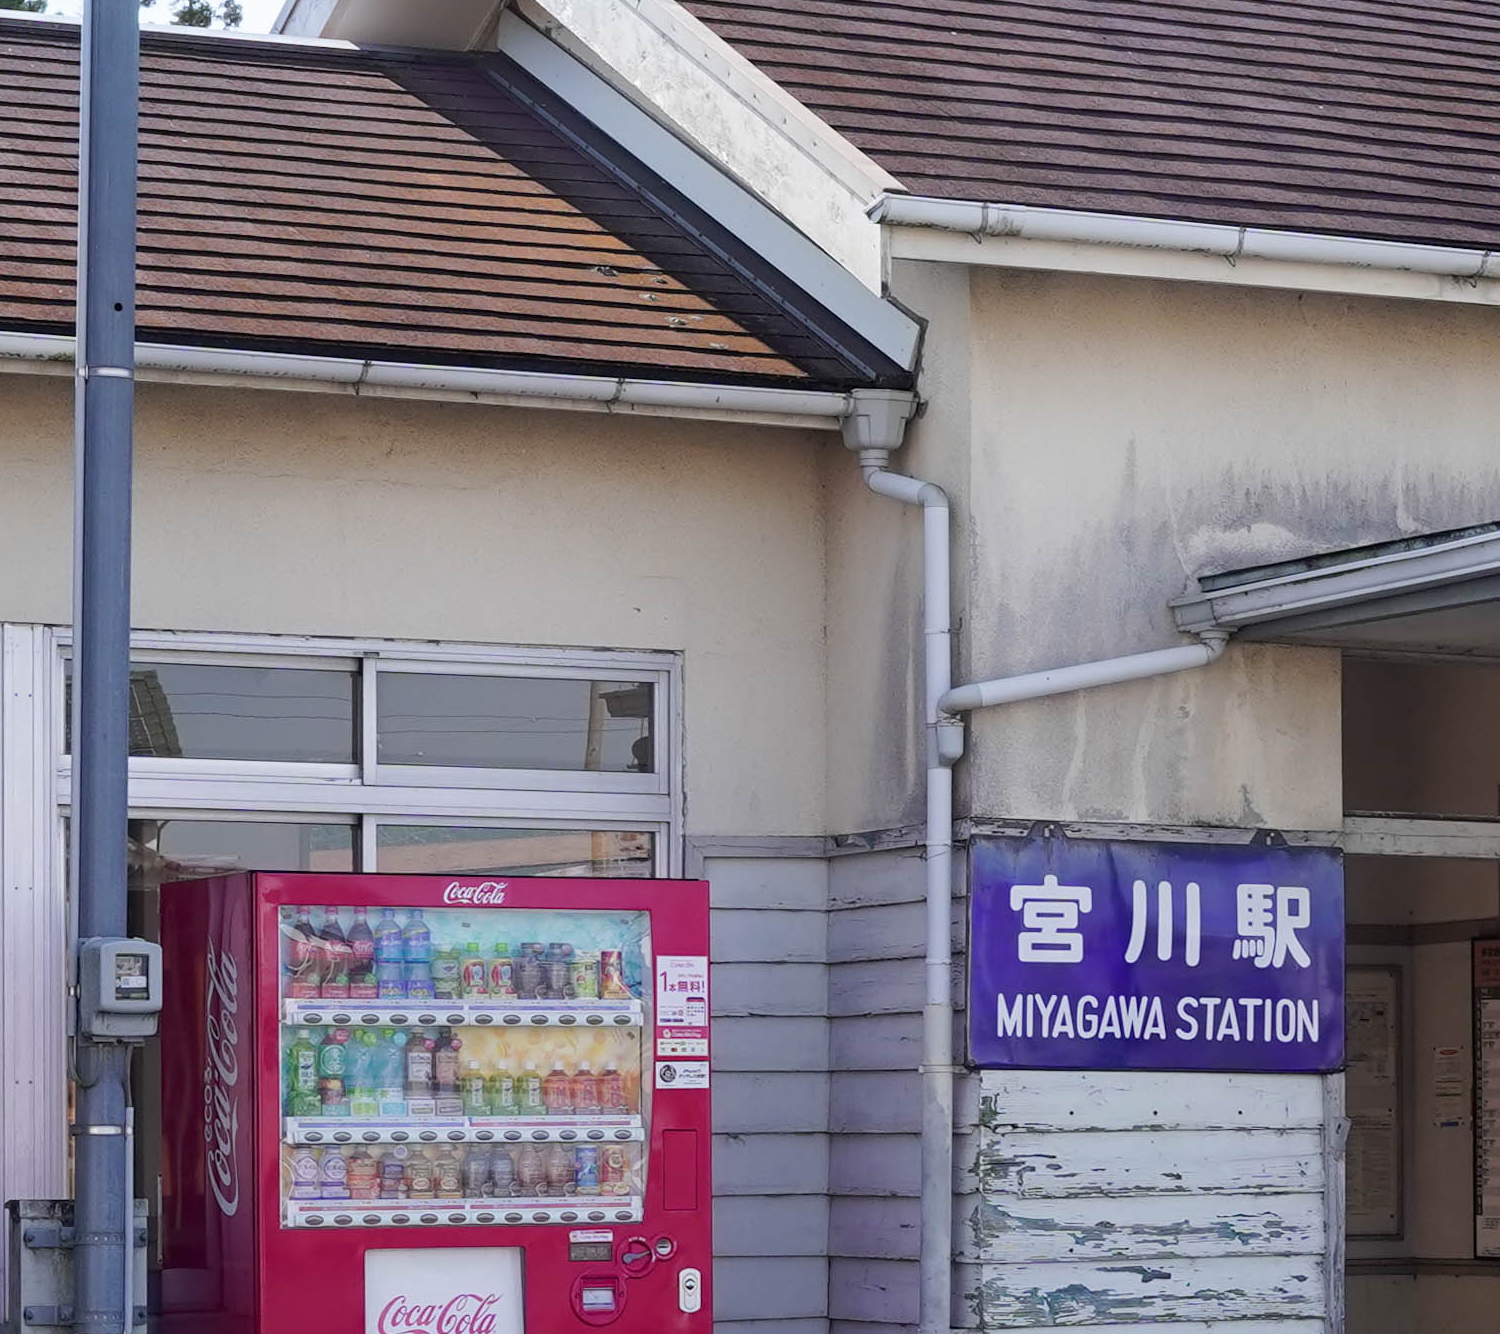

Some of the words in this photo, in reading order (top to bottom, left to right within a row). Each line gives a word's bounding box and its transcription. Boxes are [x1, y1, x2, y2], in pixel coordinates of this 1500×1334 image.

[443, 881, 505, 904] Coca-Cola
[1009, 874, 1311, 968] 宮川駅
[997, 993, 1167, 1041] MIYAGAWA
[1175, 997, 1319, 1042] STATION
